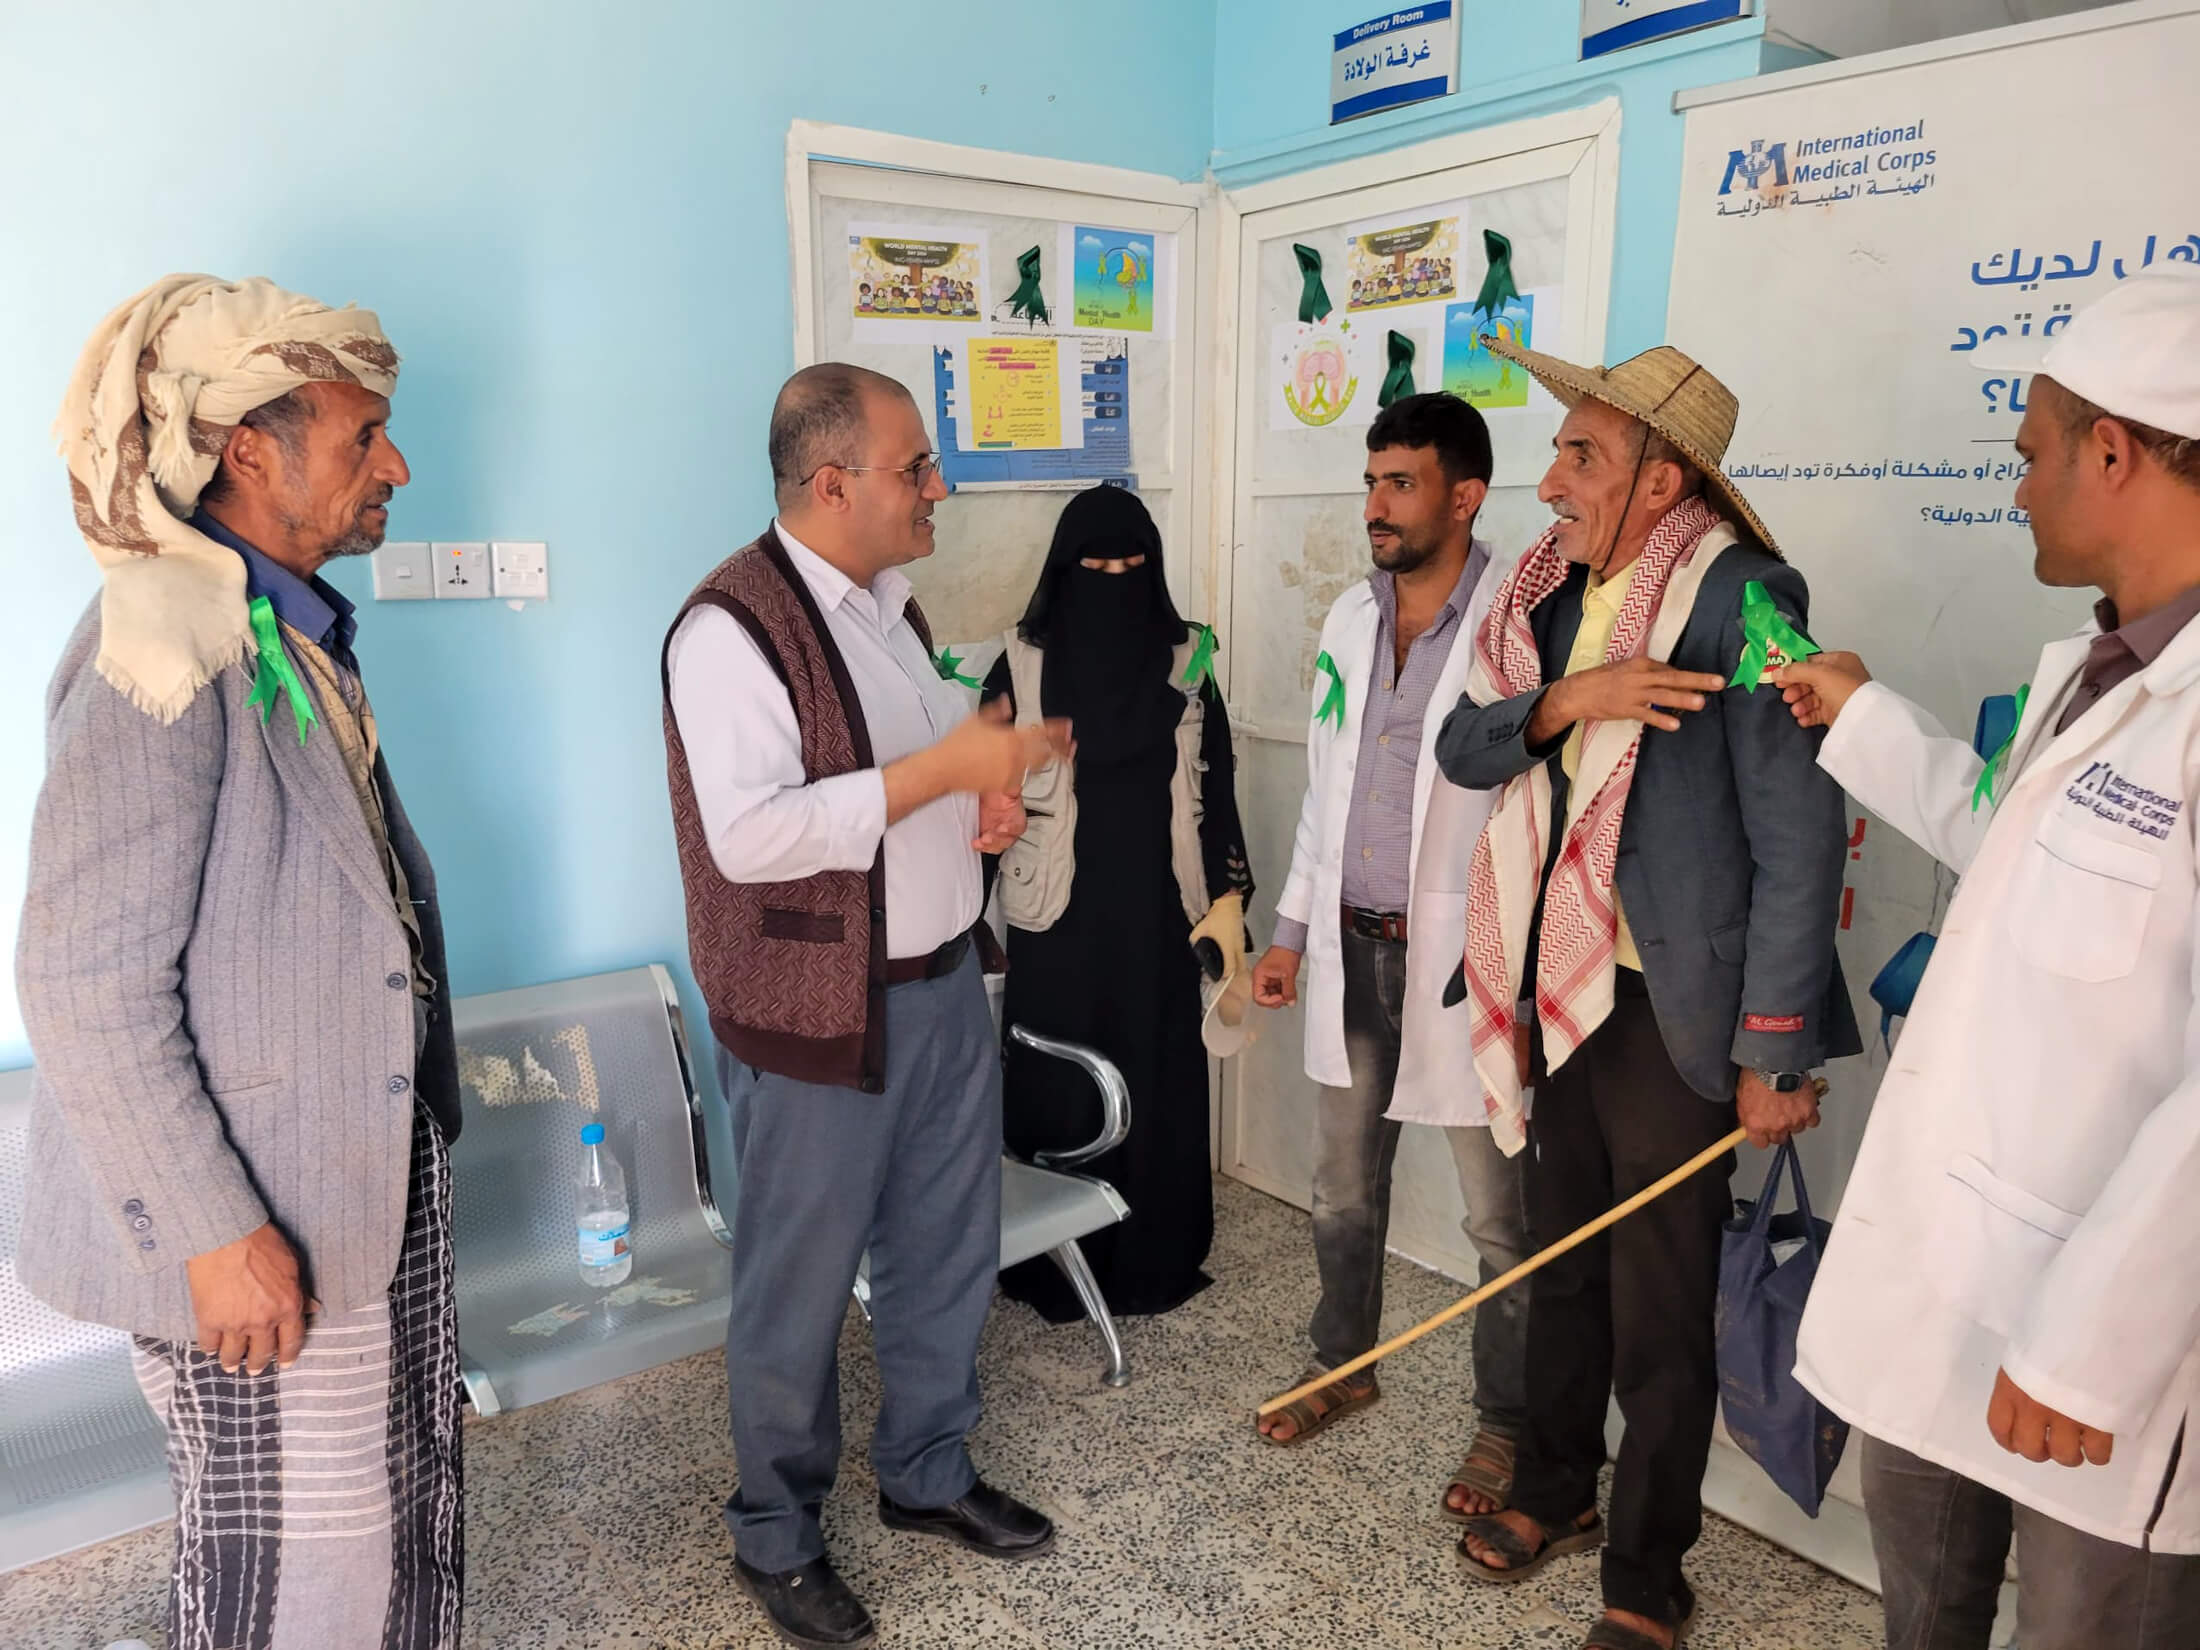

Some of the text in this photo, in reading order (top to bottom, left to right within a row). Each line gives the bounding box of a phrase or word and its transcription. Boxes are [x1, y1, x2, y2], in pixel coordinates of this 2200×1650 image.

[1353, 10, 1424, 39] Delivery Room
[1344, 39, 1431, 81] غرفة الولادة
[1796, 119, 1924, 157] International
[1792, 150, 1937, 184] Medical Corps
[1790, 184, 1861, 207] الطبية
[1866, 173, 1935, 196] الهيئة
[884, 242, 905, 250] WORLD
[1971, 240, 2102, 291] لديك
[1728, 463, 1789, 482] إيصالها
[1792, 463, 1821, 481] تود
[1892, 459, 1967, 480] مشكلة
[1972, 458, 1991, 480] أو
[1920, 505, 2001, 526] الدولية؟
[2111, 775, 2184, 813] International
[2141, 805, 2177, 827] Corps
